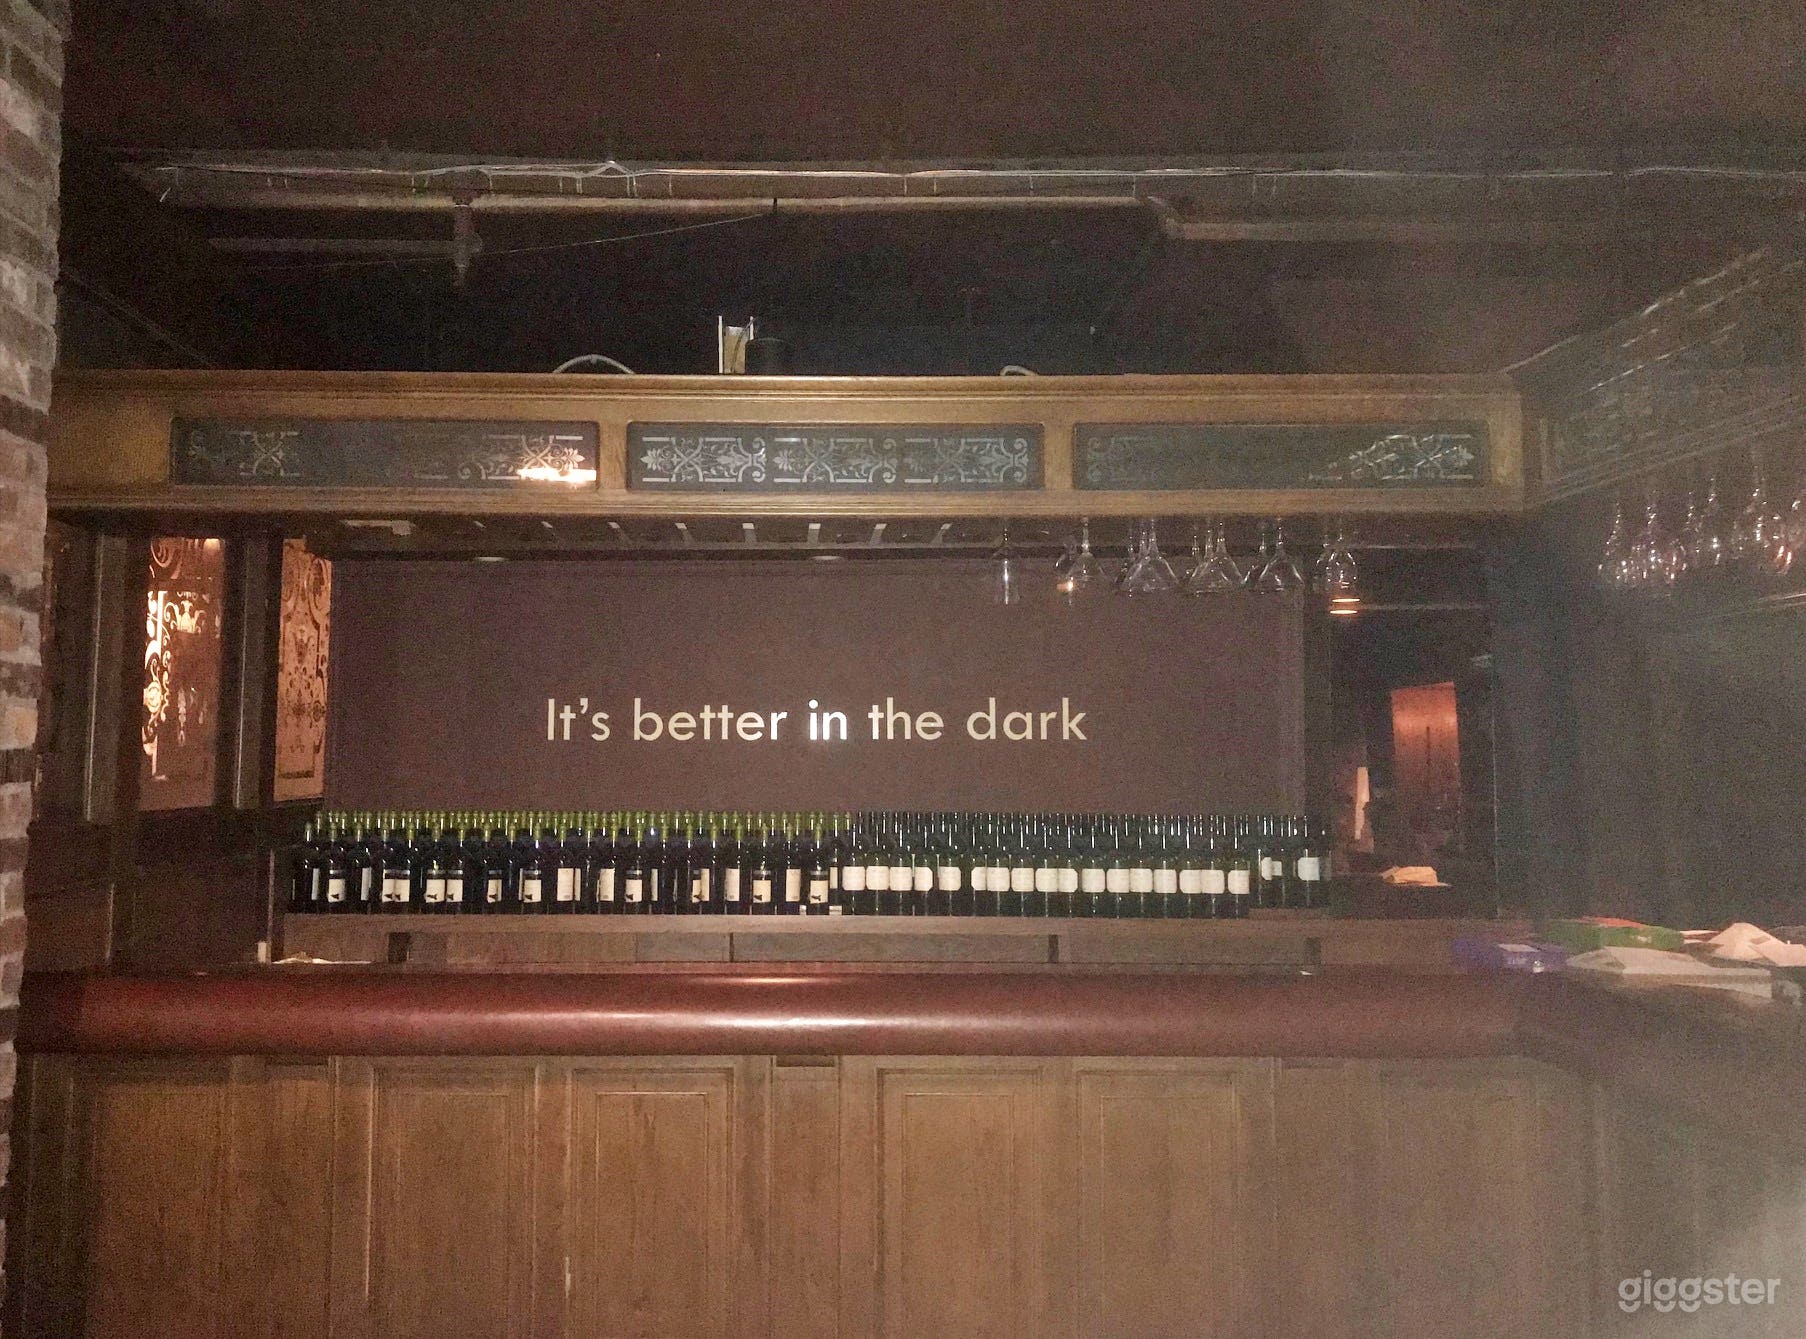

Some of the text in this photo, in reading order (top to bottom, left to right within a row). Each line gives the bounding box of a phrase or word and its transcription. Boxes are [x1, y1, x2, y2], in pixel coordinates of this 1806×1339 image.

[547, 697, 1087, 741] It's better in the dark
